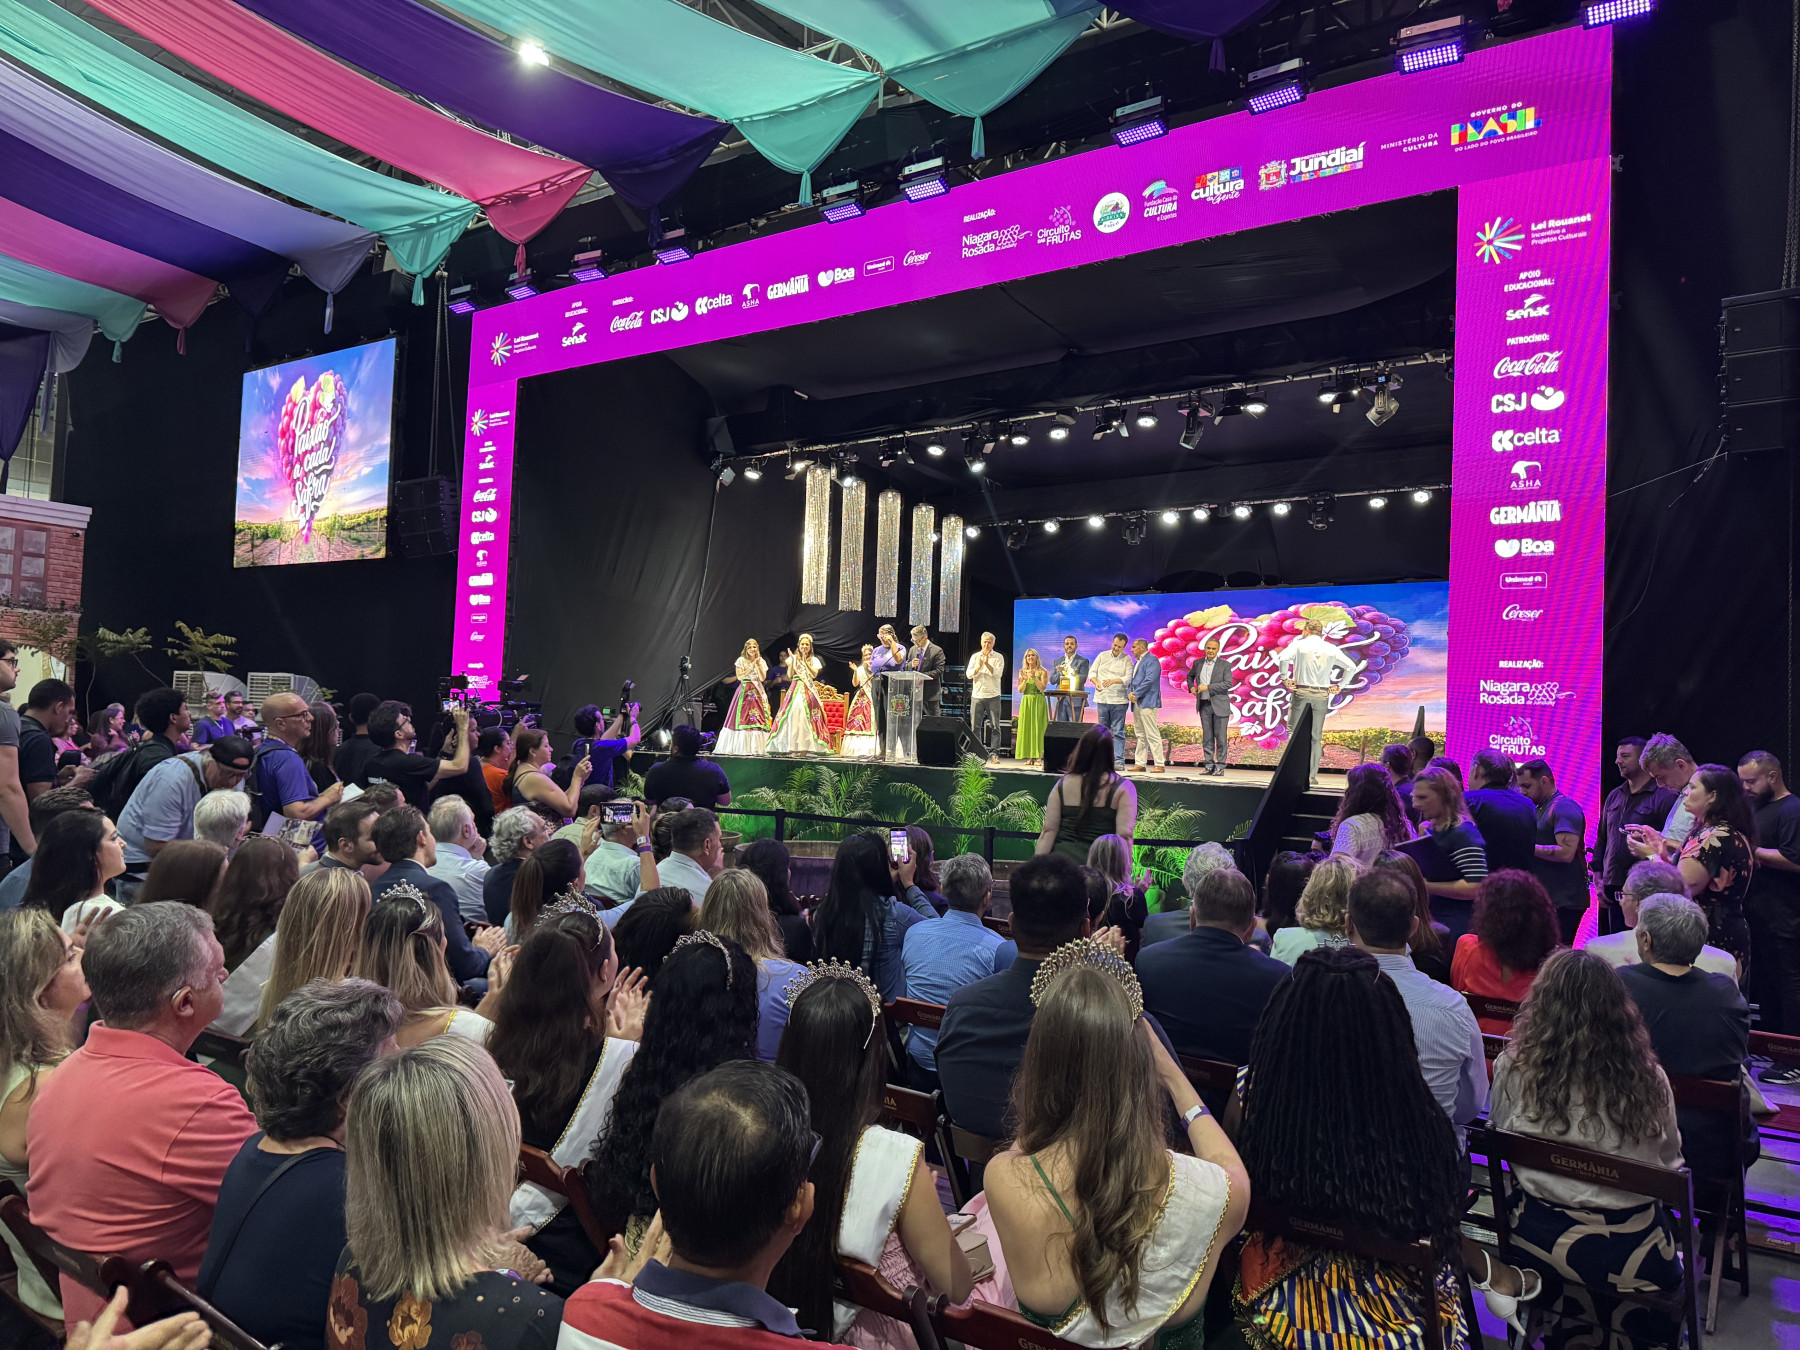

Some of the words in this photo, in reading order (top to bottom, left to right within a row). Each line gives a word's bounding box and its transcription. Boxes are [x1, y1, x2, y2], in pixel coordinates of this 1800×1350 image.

[1470, 104, 1507, 118] GOVERNO
[1511, 101, 1523, 109] DO
[1451, 106, 1543, 146] BRASIL
[1380, 134, 1425, 150] MINISTÉRIO
[1402, 140, 1439, 153] CULTURA
[1464, 142, 1479, 151] LADO
[1289, 141, 1366, 176] Jundiaí
[1191, 178, 1245, 201] cultura
[963, 208, 996, 223] REALIZAÇÃO:
[1143, 201, 1178, 218] CULTURA
[1531, 221, 1547, 231] Lei
[1548, 212, 1592, 229] Rouanet
[962, 229, 999, 248] Niagara
[1037, 225, 1070, 239] Circuito
[1046, 229, 1082, 246] FRUTAS
[903, 250, 931, 266] Cereser
[962, 242, 995, 258] Rosada
[834, 267, 855, 281] Boa
[1519, 269, 1541, 280] APOIO
[1504, 277, 1555, 292] EDUCACIONAL:
[707, 293, 733, 310] celta
[741, 298, 760, 308] ASHA
[651, 306, 670, 325] CSJ
[1506, 333, 1550, 346] PATROCÍNIO:
[1491, 391, 1527, 413] CSJ
[292, 396, 341, 457] Paixão
[1513, 427, 1560, 446] celta
[303, 437, 336, 474] cada
[1510, 479, 1541, 489] ASHA
[291, 473, 331, 522] Safra
[1521, 538, 1555, 553] Boa
[1502, 603, 1543, 620] Cereser
[1499, 659, 1544, 670] REALIZAÇÃO:
[1480, 679, 1530, 696] Niagara
[1480, 692, 1525, 705] Rosada
[1489, 734, 1531, 745] Circuito
[1501, 745, 1546, 756] FRUTAS
[1550, 1153, 1620, 1180] GERMÂNIA
